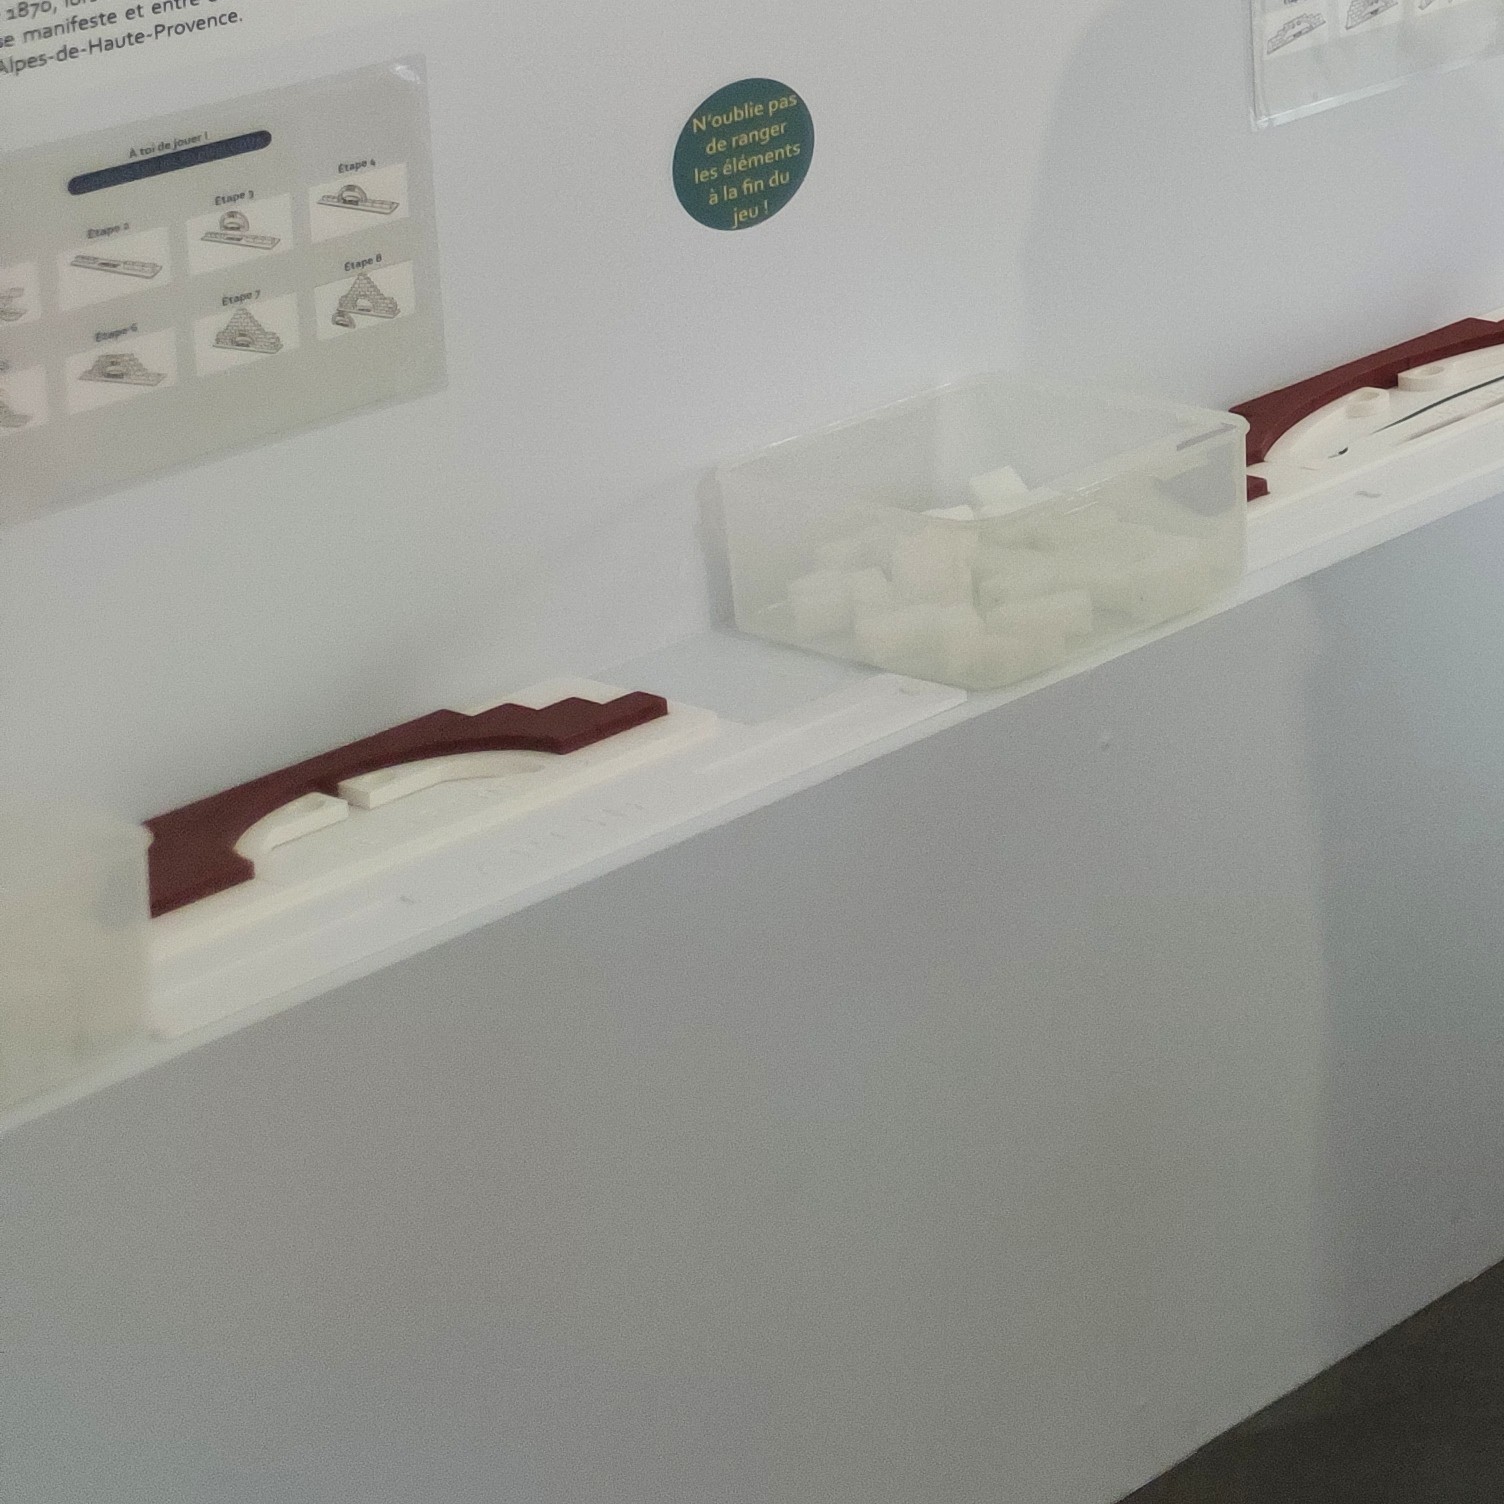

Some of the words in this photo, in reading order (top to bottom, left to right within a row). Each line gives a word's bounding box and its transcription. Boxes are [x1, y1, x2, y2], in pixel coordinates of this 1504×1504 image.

[769, 94, 798, 116] pas
[706, 138, 727, 154] de
[732, 122, 787, 148] ranger
[694, 167, 718, 184] les
[722, 144, 800, 175] éléments
[708, 188, 718, 205] à
[723, 185, 737, 200] la
[741, 177, 764, 195] fin
[768, 169, 789, 187] du
[732, 206, 758, 228] jeu
[764, 199, 767, 213] !
